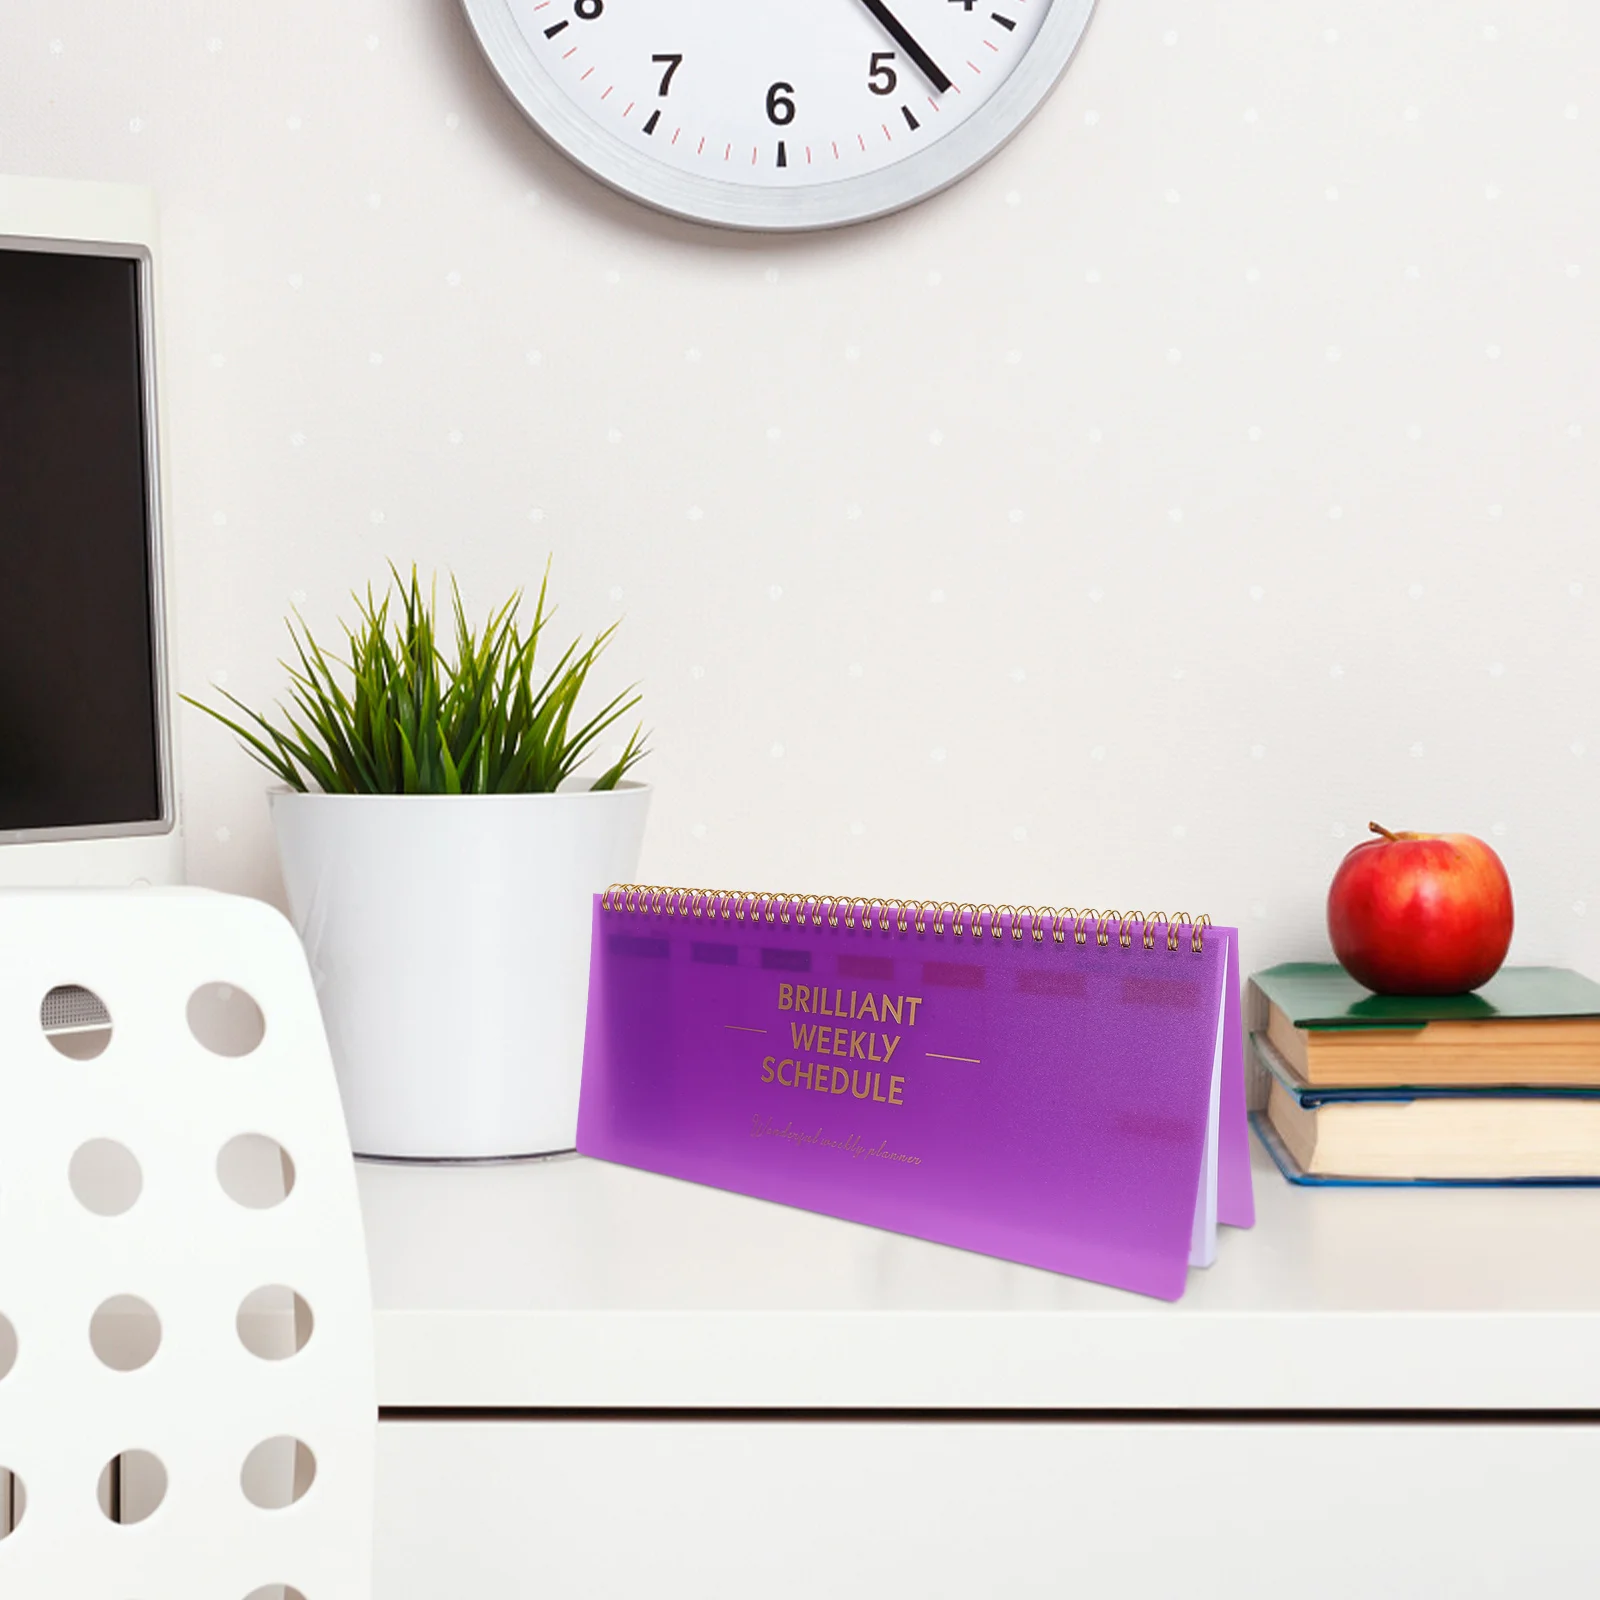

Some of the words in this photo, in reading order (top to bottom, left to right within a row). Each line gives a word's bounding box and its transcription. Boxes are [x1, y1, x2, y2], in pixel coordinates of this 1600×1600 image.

[651, 53, 683, 97] 7
[867, 51, 897, 96] 5
[765, 81, 796, 126] 6
[777, 982, 923, 1026] BRILLIANT
[790, 1021, 901, 1064] WEEKLY
[760, 1055, 906, 1106] SCHEDULE
[750, 1113, 822, 1146] Wonderful
[821, 1133, 865, 1159] weekly
[864, 1139, 922, 1165] planner
